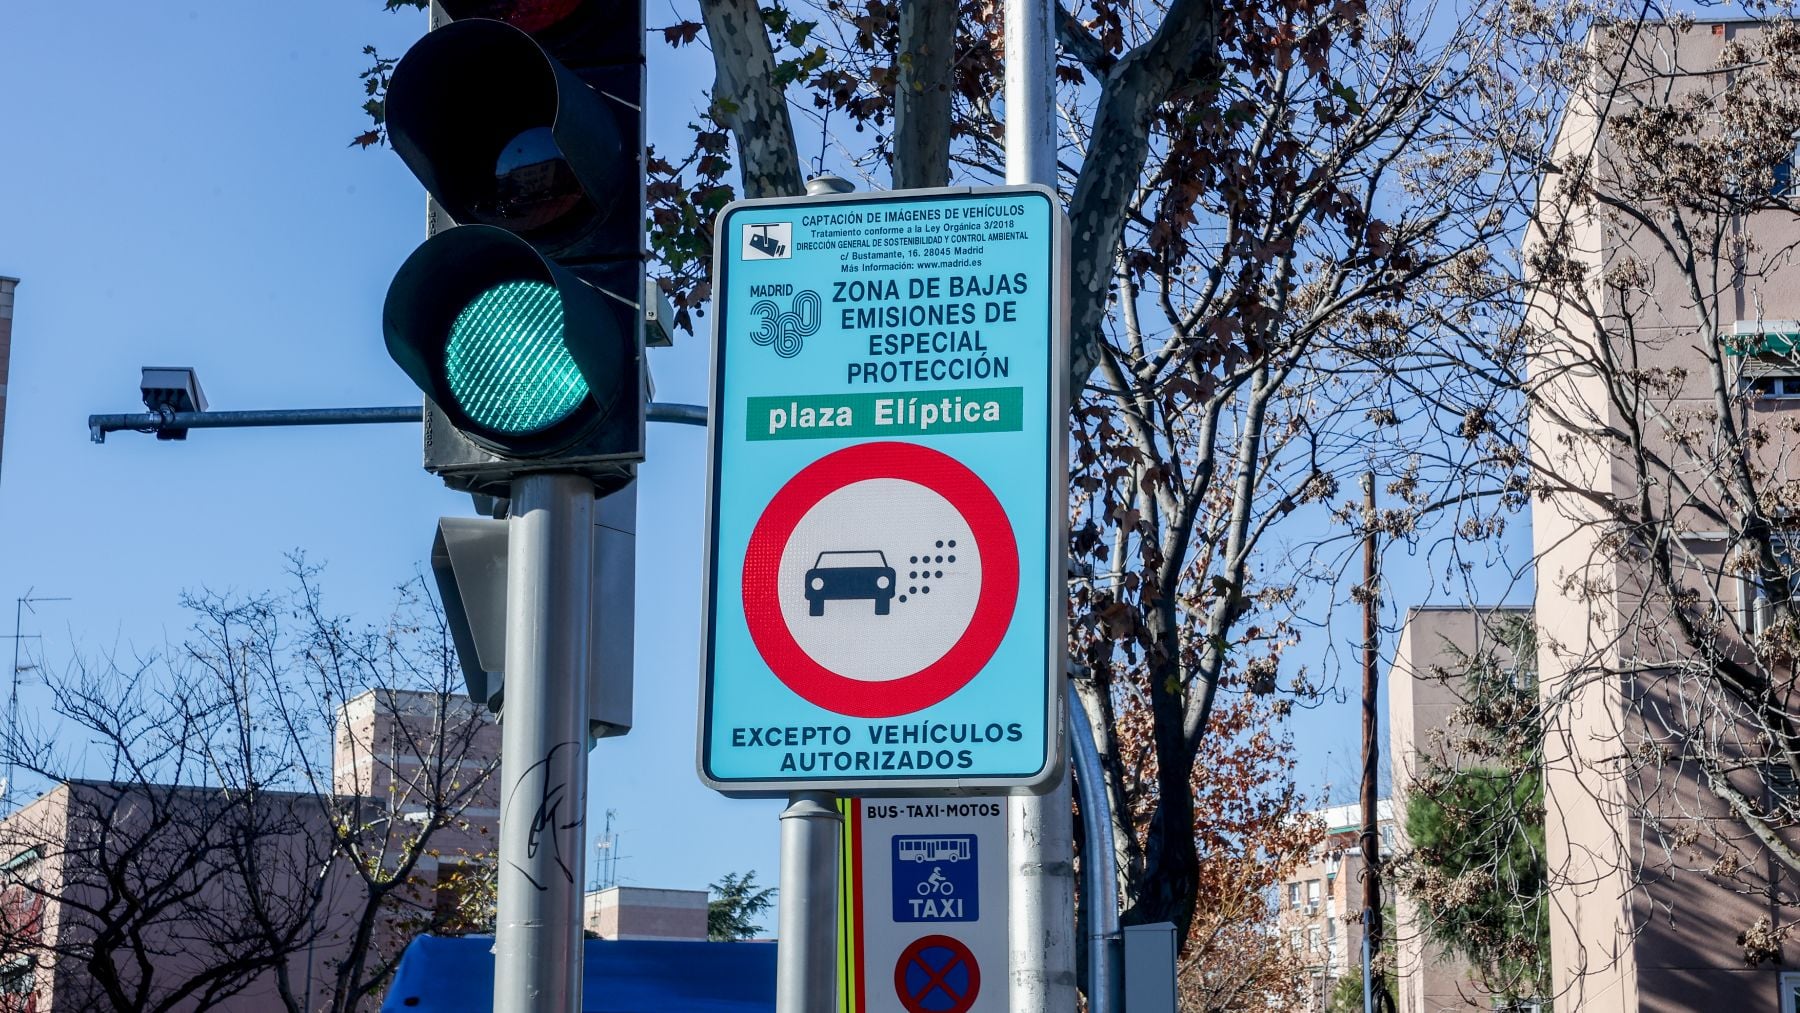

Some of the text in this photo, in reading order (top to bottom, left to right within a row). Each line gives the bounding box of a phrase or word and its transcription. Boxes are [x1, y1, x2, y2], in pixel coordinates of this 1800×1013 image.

[802, 204, 1025, 227] CAPTACIÓN DE IMÁGENES DE VEHÍCULOS
[811, 229, 862, 239] Tratamiento
[864, 226, 904, 236] conforme
[915, 225, 922, 233] la
[925, 224, 940, 234] Ley
[943, 222, 981, 233] Orgánica
[984, 220, 1015, 230] 3/2018
[796, 231, 1029, 251] DIRECCIÓN GENERAL DE SOSTENIBILIDAD Y CONTROL AMBIENTAL
[840, 246, 984, 261] c/ Bustamante, 16. 28045 Madrid
[841, 258, 982, 273] Más Información: www.madrid.es
[750, 284, 794, 298] MADRID
[832, 272, 1028, 303] ZONA DE BAJAS
[841, 300, 1017, 329] EMISIONES DE
[869, 330, 988, 356] ESPECIAL
[847, 352, 1009, 384] PROTECCIÓN
[769, 396, 1000, 434] plaza Elíptica
[732, 720, 1023, 747] EXCEPTO VEHÍCULOS
[780, 750, 973, 772] AUTORIZADOS
[908, 899, 964, 918] TAXI
